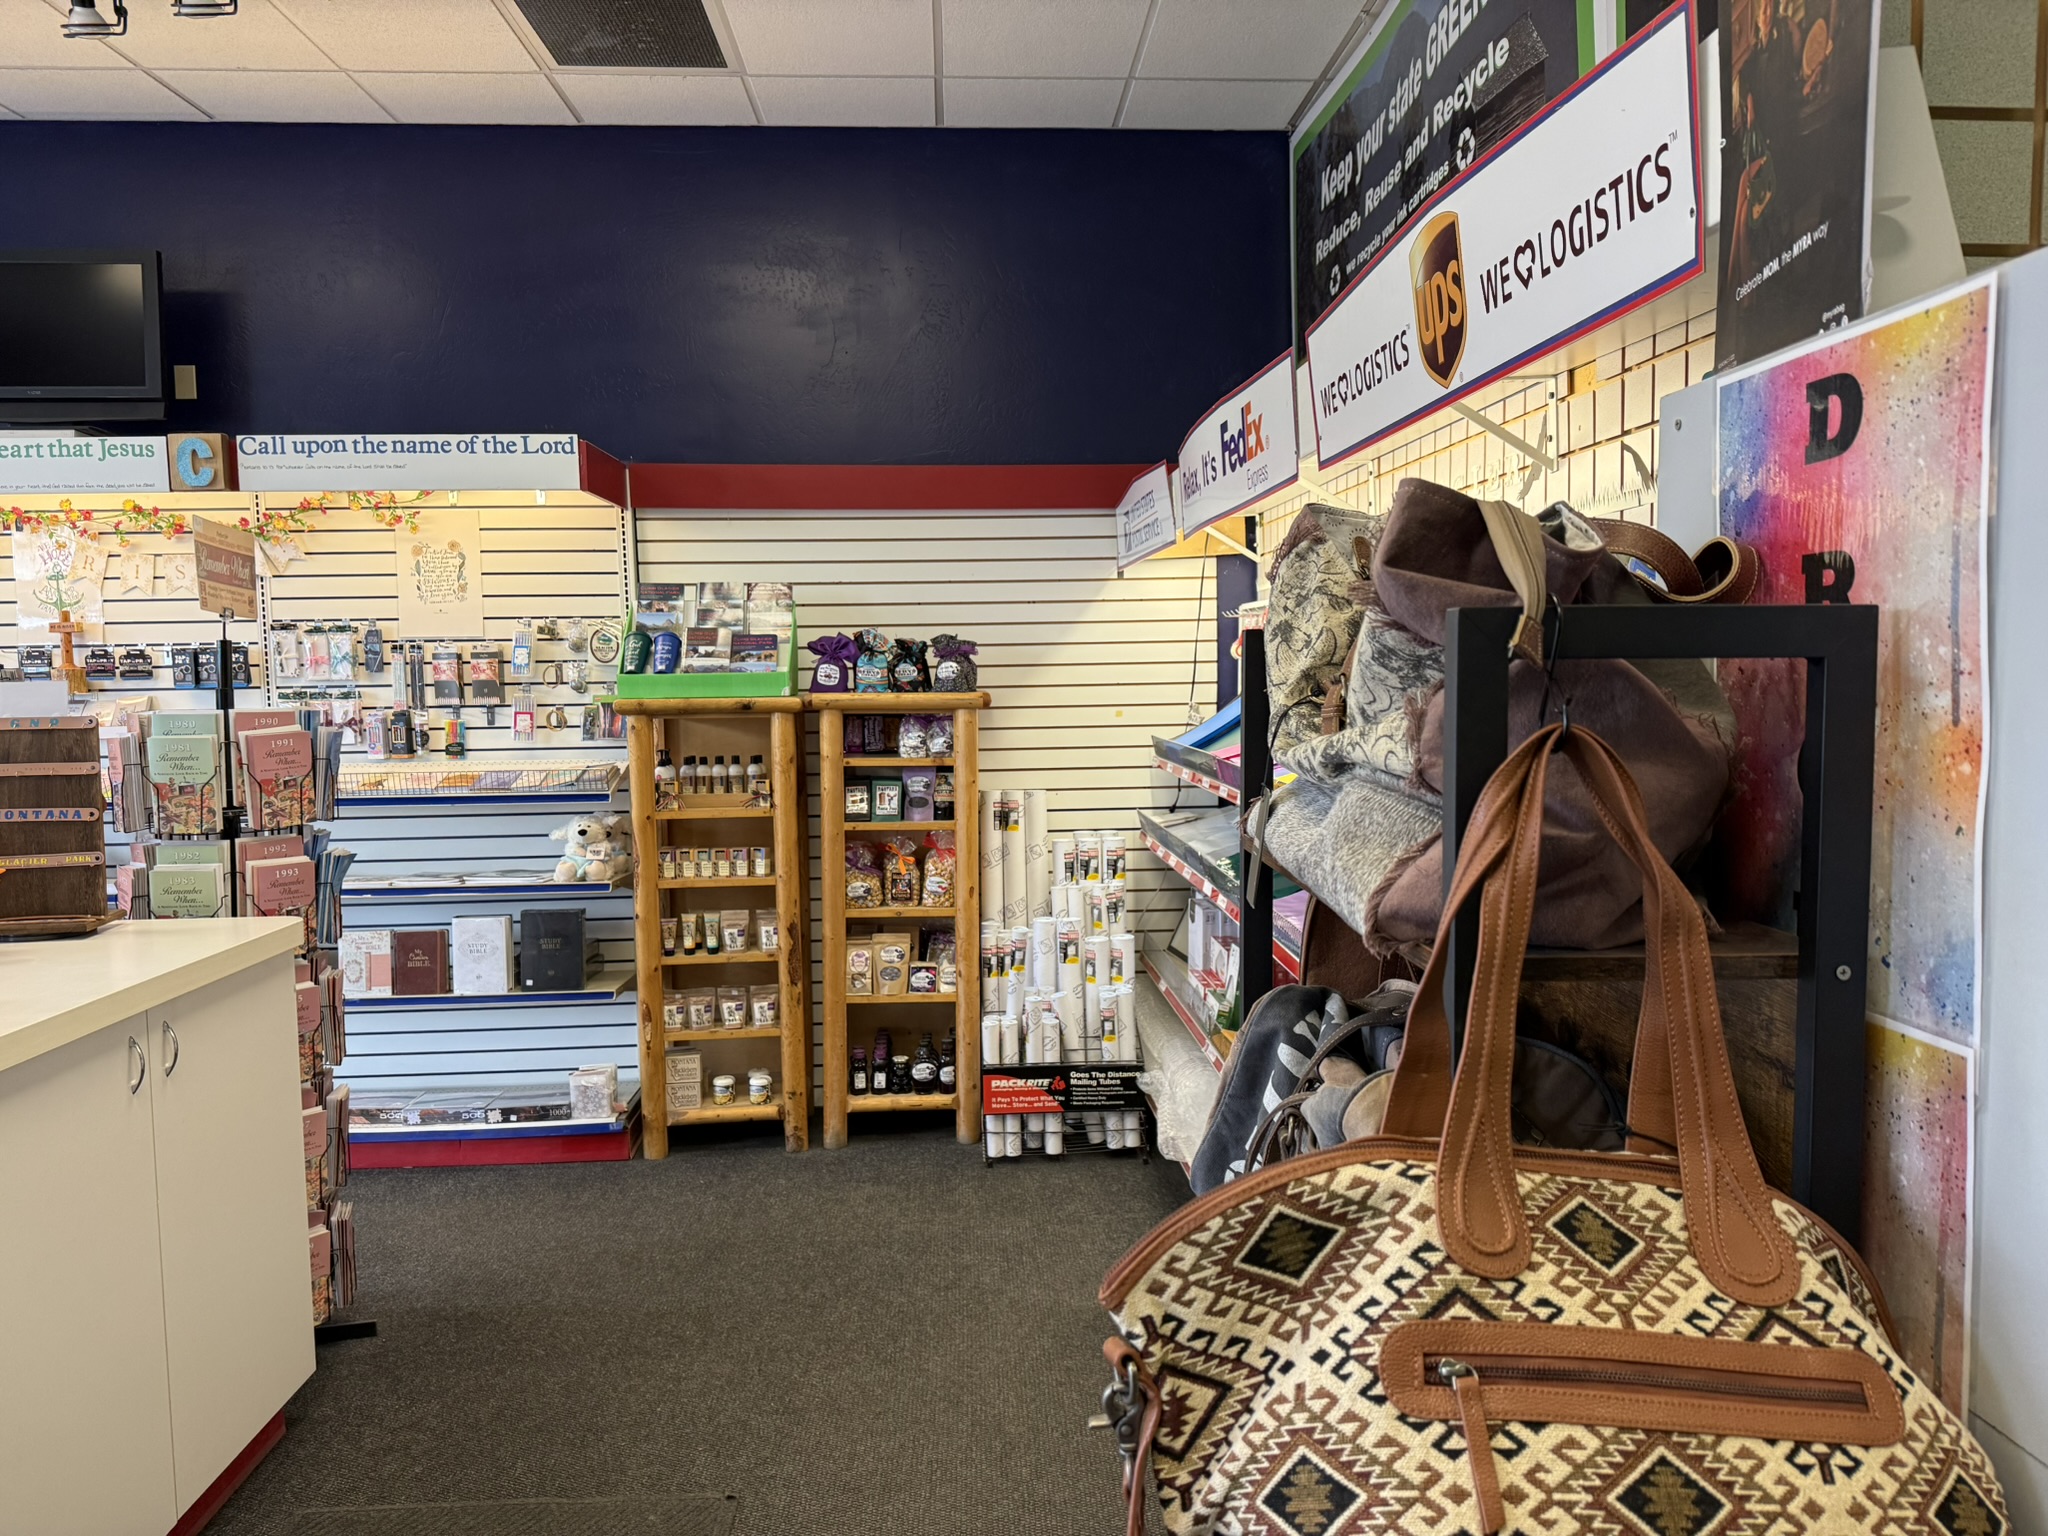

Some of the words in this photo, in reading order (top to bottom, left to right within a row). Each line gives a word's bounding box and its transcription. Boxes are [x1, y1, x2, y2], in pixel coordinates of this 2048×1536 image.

[1321, 150, 1353, 212] Keep
[1355, 107, 1386, 186] your
[1388, 57, 1422, 136] state
[1315, 210, 1361, 266] Reduce,
[1365, 160, 1402, 218] Reuse
[1404, 117, 1428, 172] and
[1433, 37, 1510, 138] Recycle
[1346, 256, 1356, 275] we
[1357, 235, 1380, 266] recycle
[1381, 217, 1397, 246] your
[1397, 203, 1408, 226] ink
[1408, 160, 1449, 211] cartridges
[1480, 256, 1512, 314] WE
[1538, 142, 1672, 279] LOGISTICS
[1736, 272, 1763, 302] Celebrate
[1781, 250, 1791, 267] the
[1792, 232, 1812, 258] MYRA
[1813, 221, 1829, 243] way
[1416, 259, 1463, 365] ups
[1320, 381, 1338, 418] WE
[1349, 329, 1410, 401] LOGISTICS
[47, 438, 93, 458] that
[98, 438, 155, 462] Jesus
[238, 435, 287, 456] Call
[291, 438, 348, 458] upon
[351, 435, 387, 455] the
[391, 439, 452, 455] name
[456, 435, 479, 454] of
[482, 436, 517, 454] the
[520, 435, 576, 455] Lord
[1183, 465, 1202, 504] Relax,
[1202, 450, 1217, 488] It's
[1220, 400, 1265, 477] FedEx
[176, 437, 216, 488] C
[1246, 463, 1269, 492] Express
[169, 720, 197, 728] 1980
[255, 717, 279, 726] 1990
[165, 744, 192, 752] 1981
[271, 738, 294, 748] 1991
[156, 753, 200, 762] Remember
[262, 748, 301, 759] Remember
[0, 809, 82, 820] ONTANA
[264, 844, 287, 855] 1992
[65, 855, 92, 863] PARK
[174, 852, 200, 860] 1982
[275, 868, 299, 878] 1993
[169, 876, 195, 885] 1983
[267, 879, 305, 889] Remember
[160, 886, 203, 895] Remember
